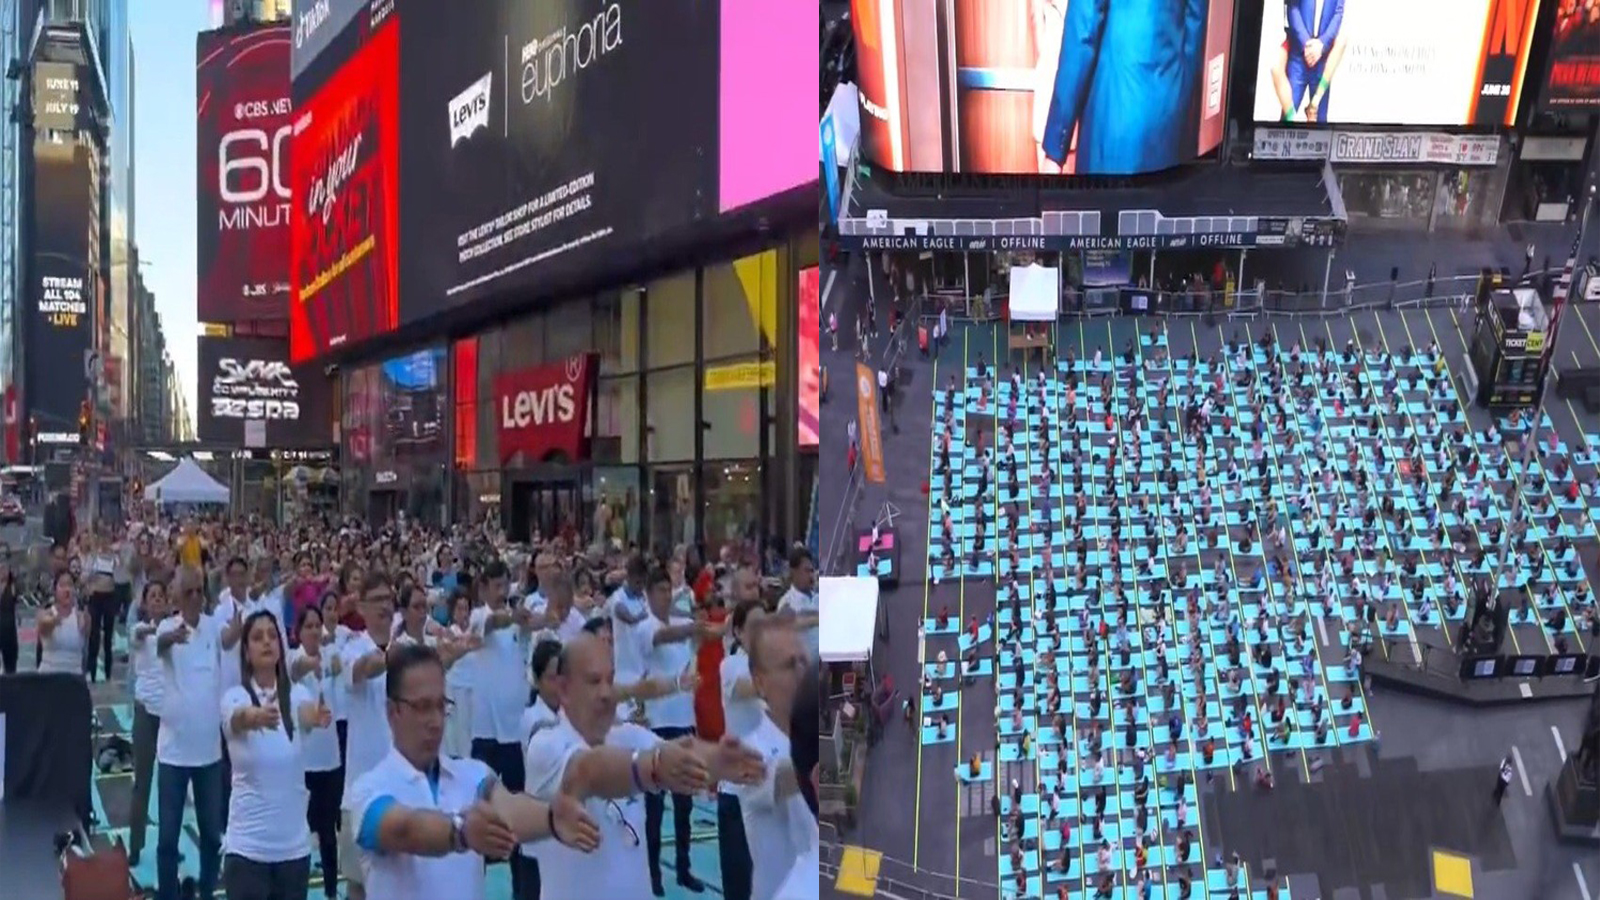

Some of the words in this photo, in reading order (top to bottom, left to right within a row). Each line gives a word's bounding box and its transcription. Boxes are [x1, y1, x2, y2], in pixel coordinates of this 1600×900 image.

[522, 0, 622, 104] euphoria
[46, 78, 69, 90] JUNE
[46, 103, 68, 114] JULY
[245, 101, 269, 117] CBS
[1337, 134, 1384, 159] GRAND
[1383, 135, 1422, 160] SLAM
[309, 176, 325, 216] in
[322, 132, 362, 225] your
[862, 237, 917, 248] AMERICAN
[923, 237, 954, 248] EAGLE
[1001, 237, 1046, 248] OFFLINE
[1070, 237, 1122, 248] AMERICAN
[1127, 236, 1157, 248] EAGLE
[1200, 234, 1242, 246] OFFLINE
[42, 276, 82, 290] STREAM
[44, 288, 63, 300] ALL
[39, 300, 86, 313] MATCHES
[54, 313, 77, 326] LIVE
[1505, 338, 1526, 348] TICKET
